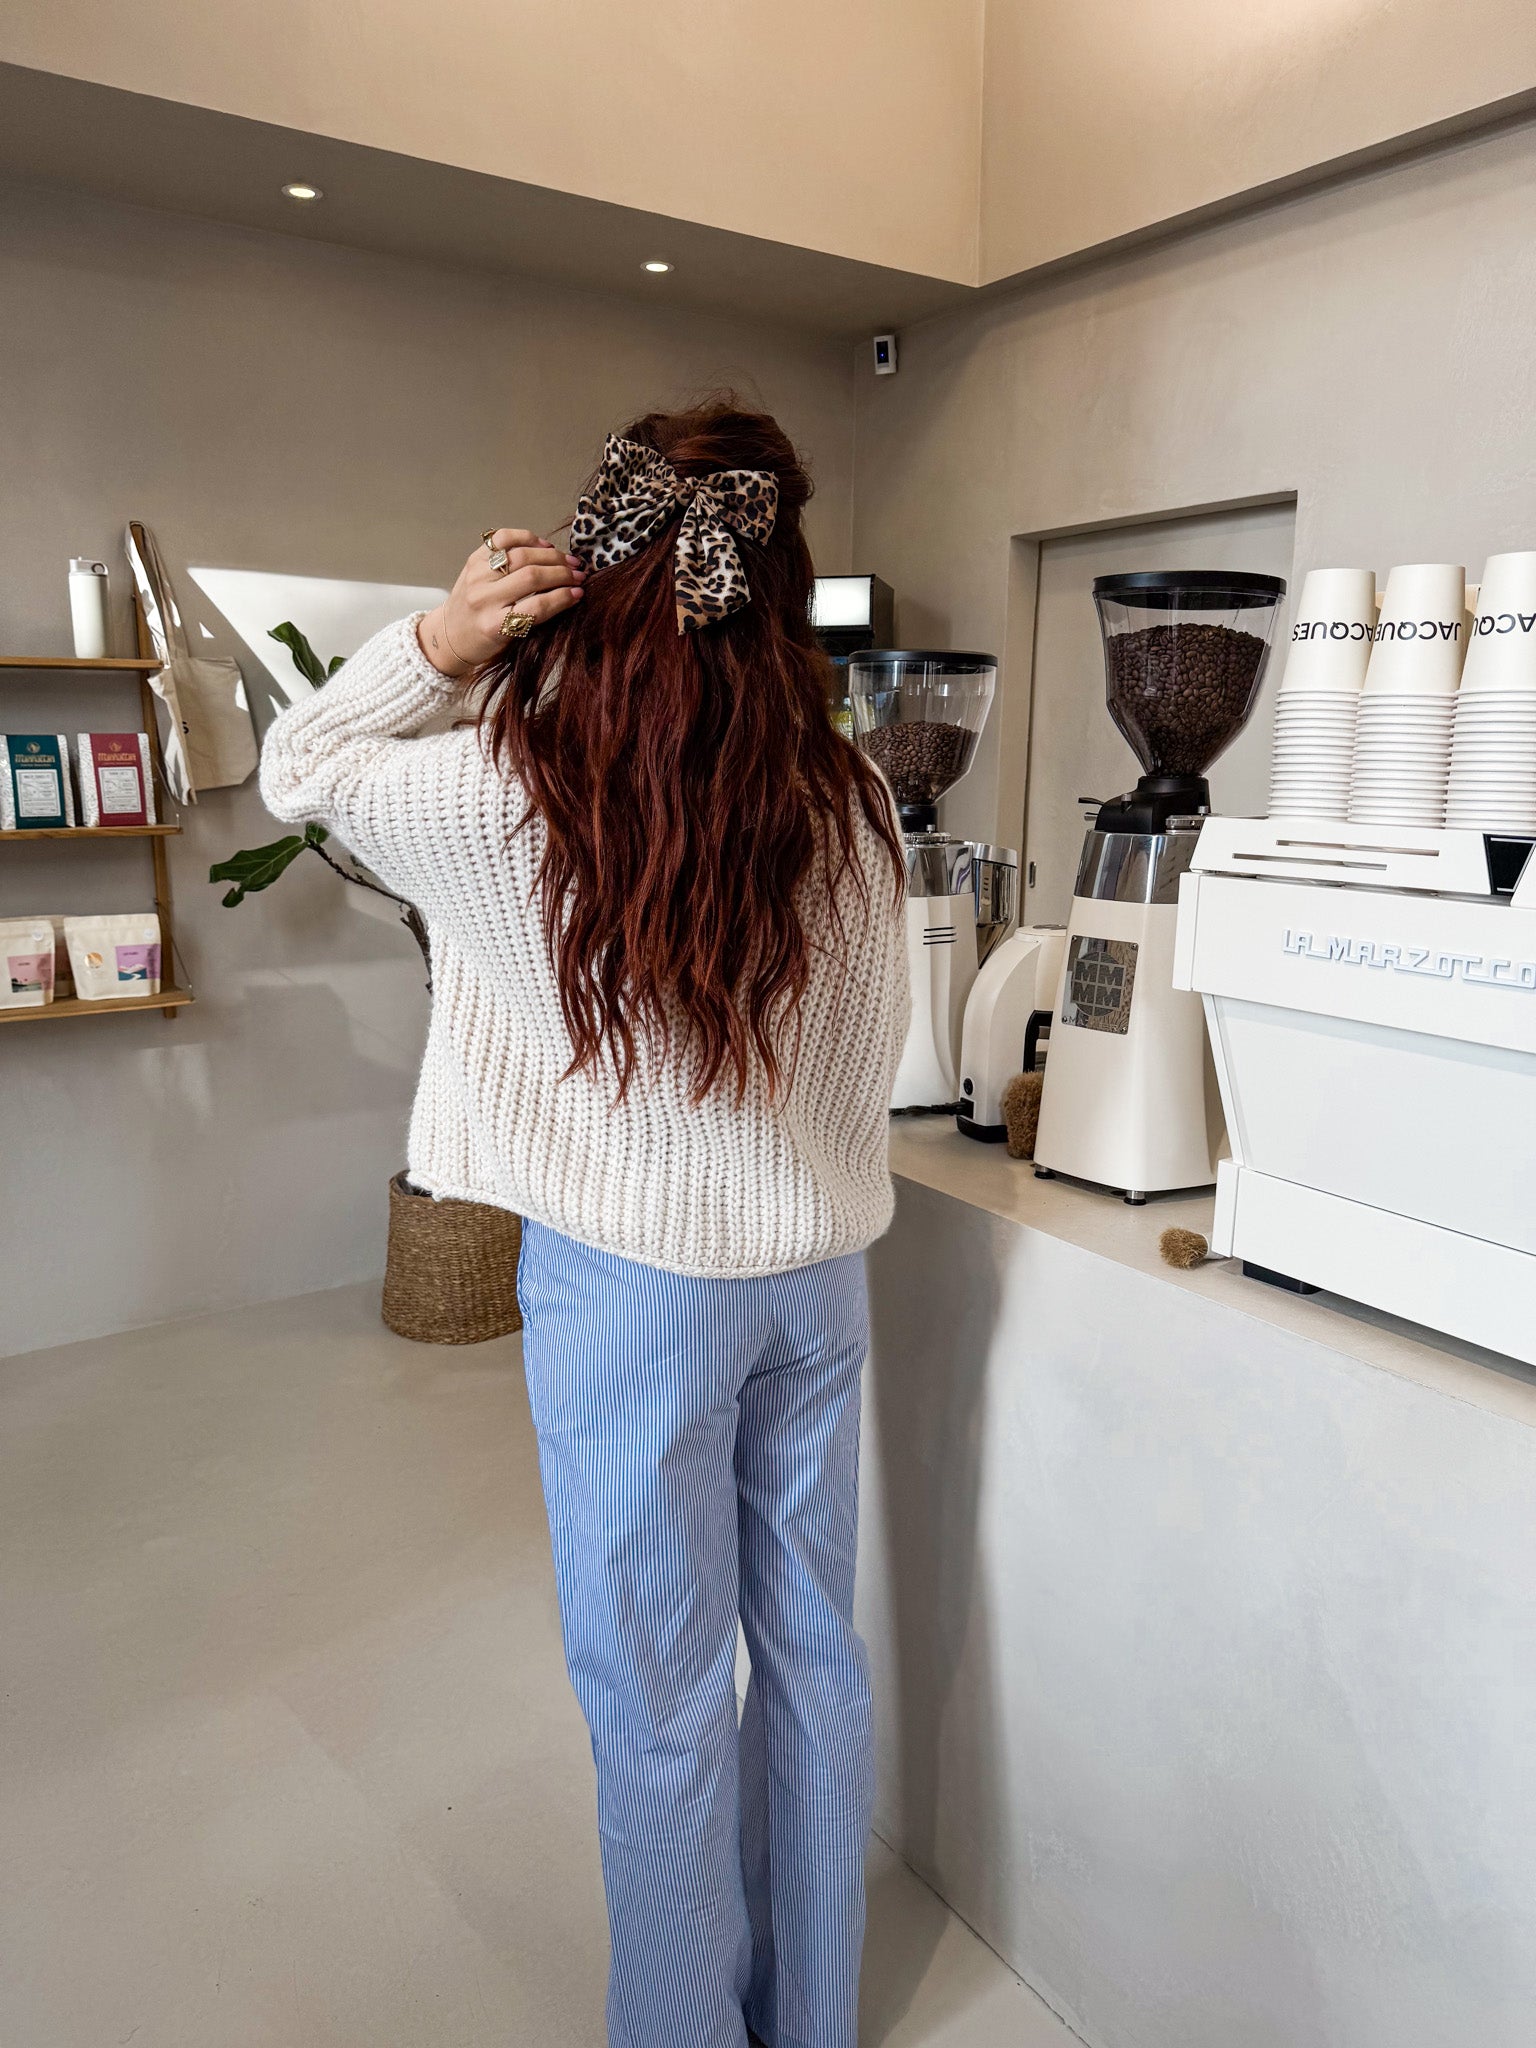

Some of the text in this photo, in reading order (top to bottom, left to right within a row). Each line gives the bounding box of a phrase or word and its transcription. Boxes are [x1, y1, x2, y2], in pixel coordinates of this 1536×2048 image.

[1292, 621, 1374, 642] ACQUES
[1375, 620, 1462, 642] JACQUE
[1283, 928, 1316, 955] LA
